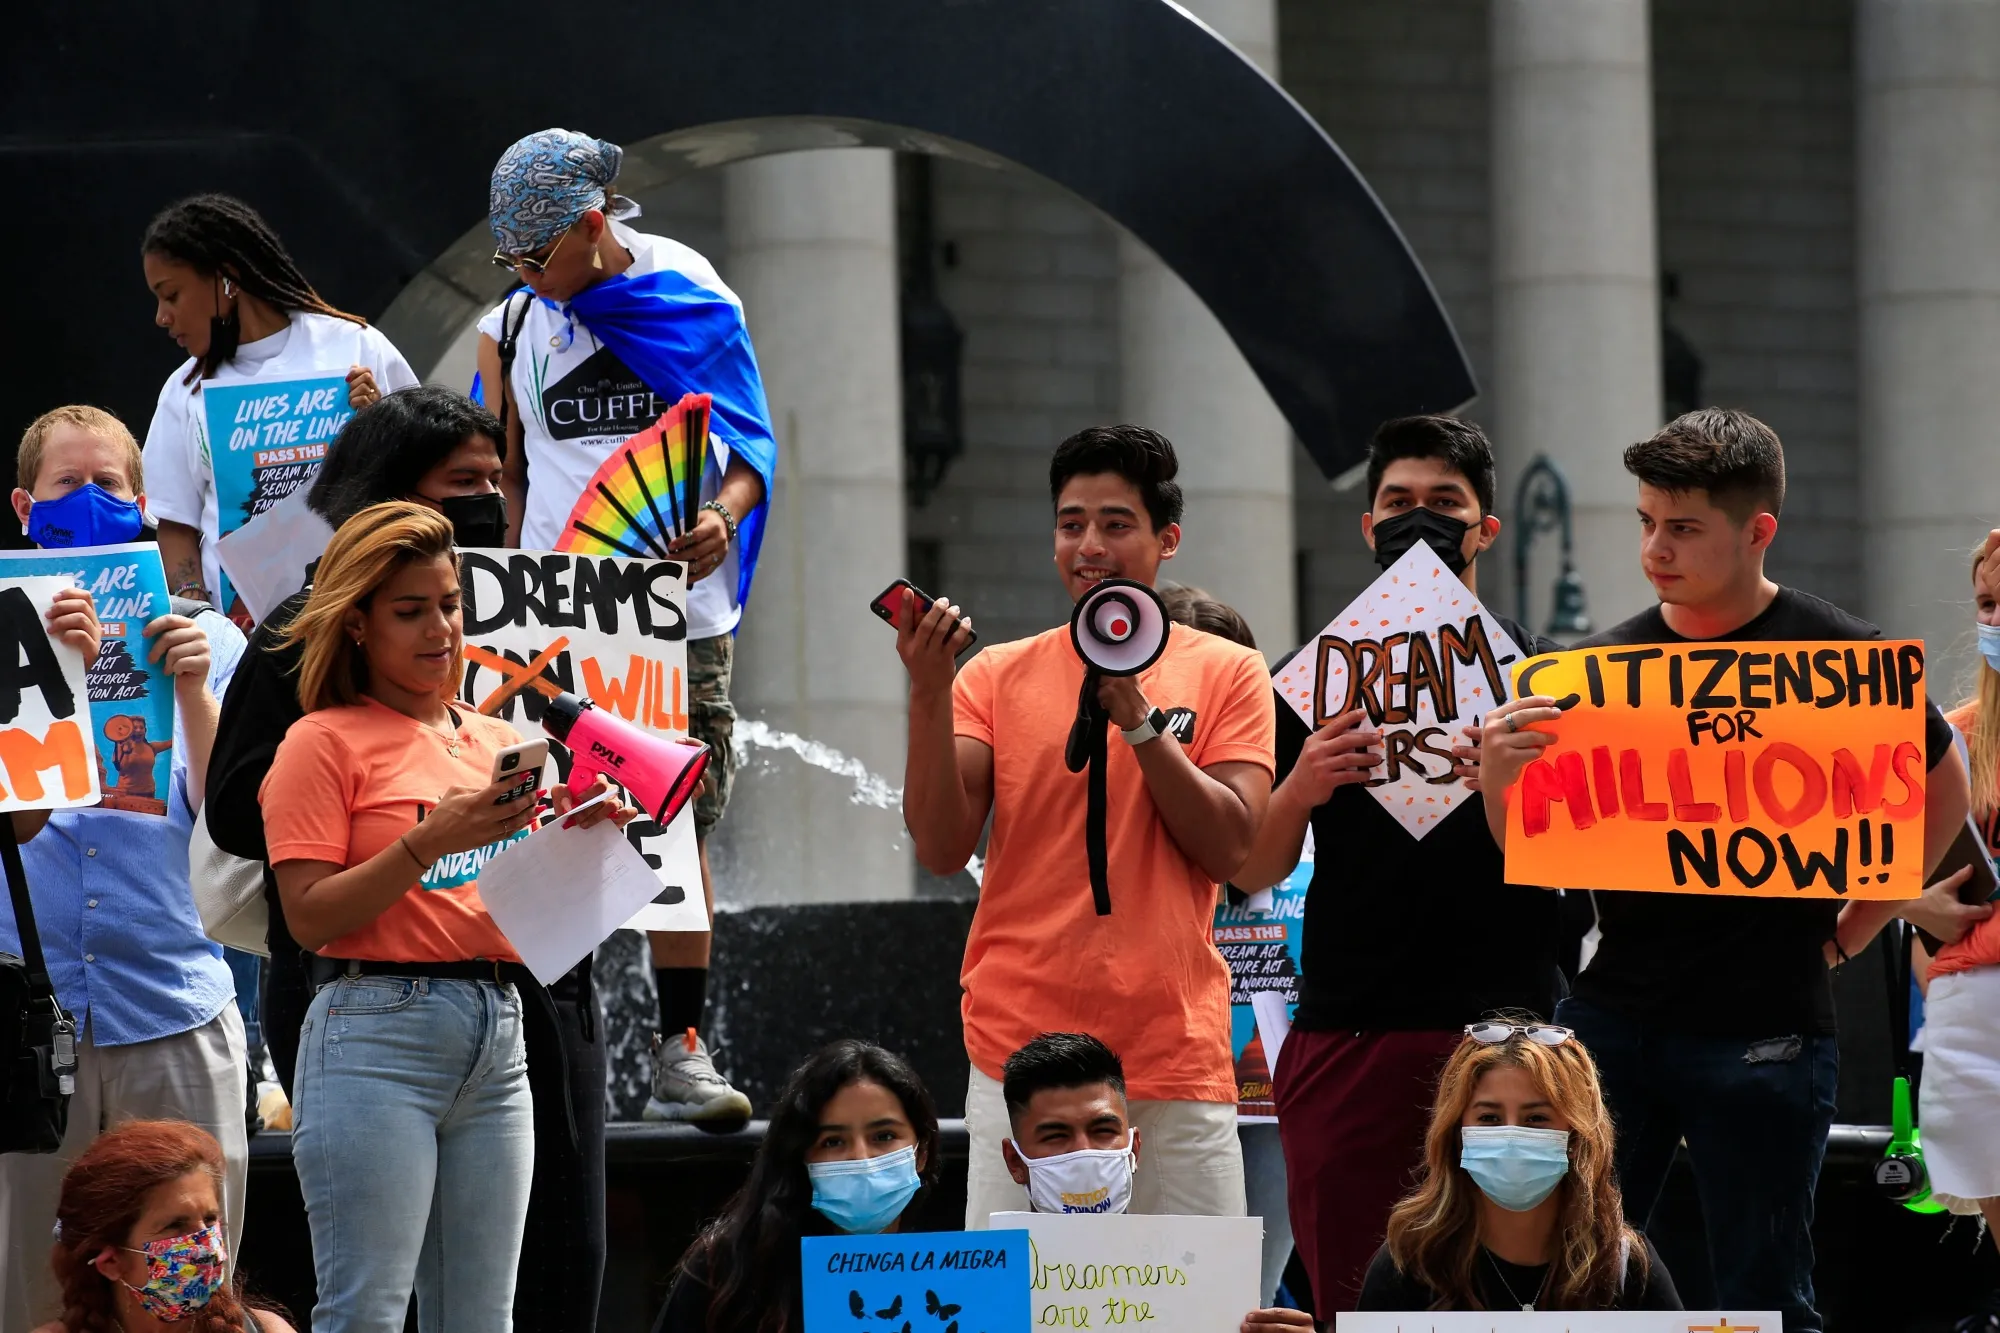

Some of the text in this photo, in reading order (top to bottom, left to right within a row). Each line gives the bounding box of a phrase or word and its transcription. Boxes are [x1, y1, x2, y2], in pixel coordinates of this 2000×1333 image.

[616, 381, 642, 391] United
[234, 387, 339, 424] LIVES ARE
[229, 423, 260, 451] ON
[263, 420, 304, 446] THE
[258, 444, 325, 465] PASS THE
[259, 463, 301, 483] DREAM
[89, 564, 139, 595] ARE
[99, 591, 154, 620] LINE
[461, 551, 688, 642] DREAMS
[91, 655, 121, 672] ACT
[1517, 644, 1925, 712] CITIZENSHIP
[113, 685, 141, 700] ACT
[580, 654, 689, 732] WILL
[1686, 709, 1764, 746] FOR
[591, 741, 626, 769] PYLE
[1521, 741, 1925, 838] MILLIONS
[1667, 818, 1894, 895] NOW!!
[1214, 926, 1283, 941] PASS THE
[1259, 944, 1284, 959] ACT
[1261, 959, 1286, 975] ACT
[1240, 975, 1296, 990] WORKFORCE
[827, 1249, 1007, 1274] CHINGA LA MIGRA
[1036, 1297, 1155, 1329] are the
